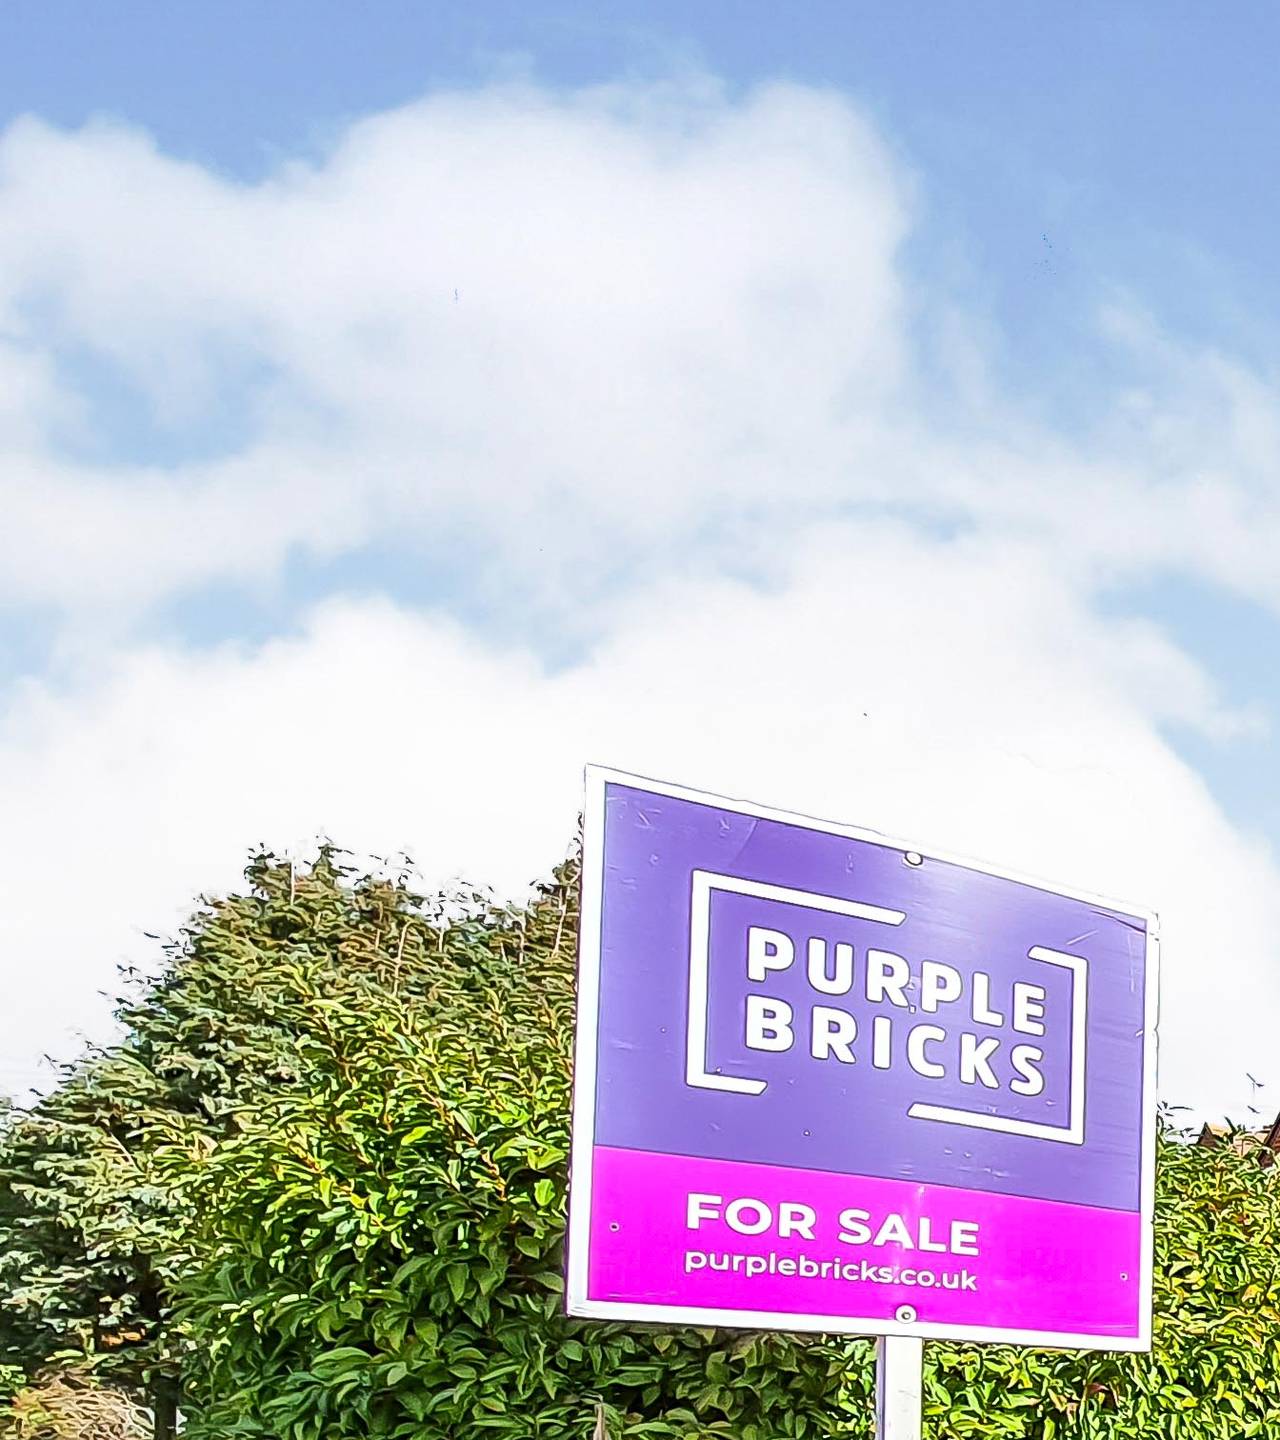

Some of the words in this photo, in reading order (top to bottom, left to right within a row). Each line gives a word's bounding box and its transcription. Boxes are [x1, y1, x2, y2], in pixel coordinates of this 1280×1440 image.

[747, 926, 1046, 1037] PURPLE
[744, 995, 1046, 1096] BRICKS
[686, 1192, 816, 1240] FOR
[838, 1209, 980, 1257] SALE
[685, 1250, 978, 1292] purplebricks.co.uk
